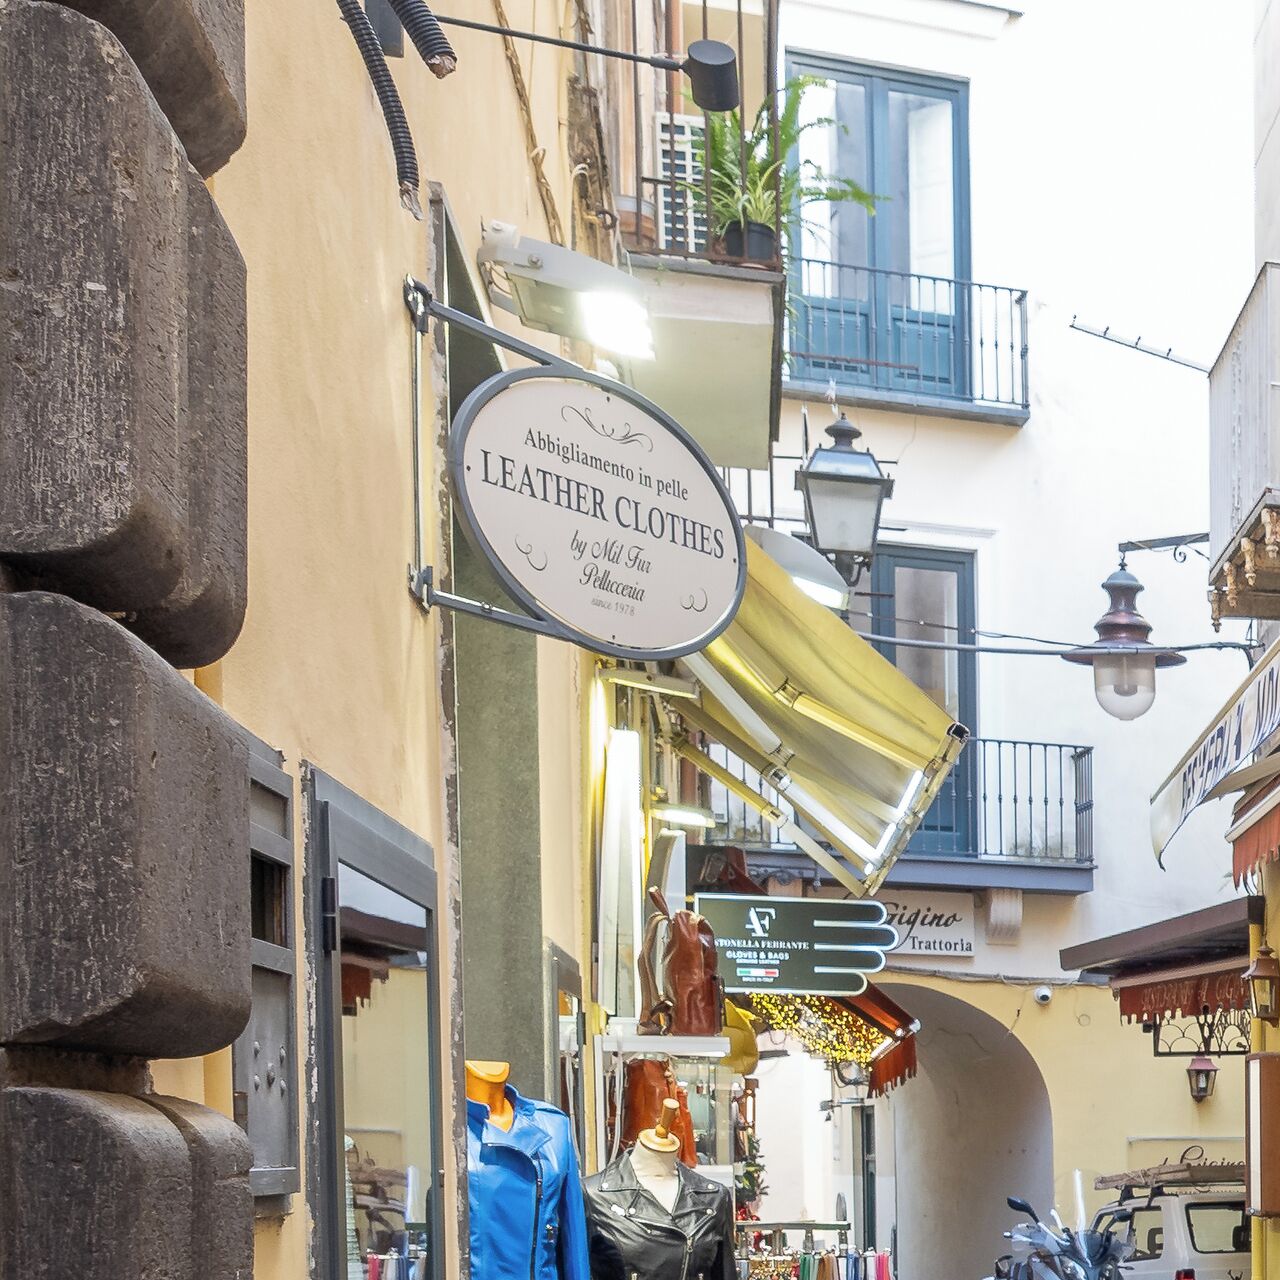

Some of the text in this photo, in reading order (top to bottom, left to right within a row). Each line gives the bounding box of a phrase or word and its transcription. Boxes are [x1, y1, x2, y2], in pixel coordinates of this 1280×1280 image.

[524, 427, 689, 501] Abbigliamento in pelle
[480, 448, 725, 560] LEATHER CLOTHES
[570, 529, 652, 574] by Mil Fur
[579, 562, 646, 602] Pellicceria
[725, 950, 790, 961] GLOVES & BAGS
[761, 940, 810, 950] FERRANTE
[910, 936, 973, 952] Trattoria
